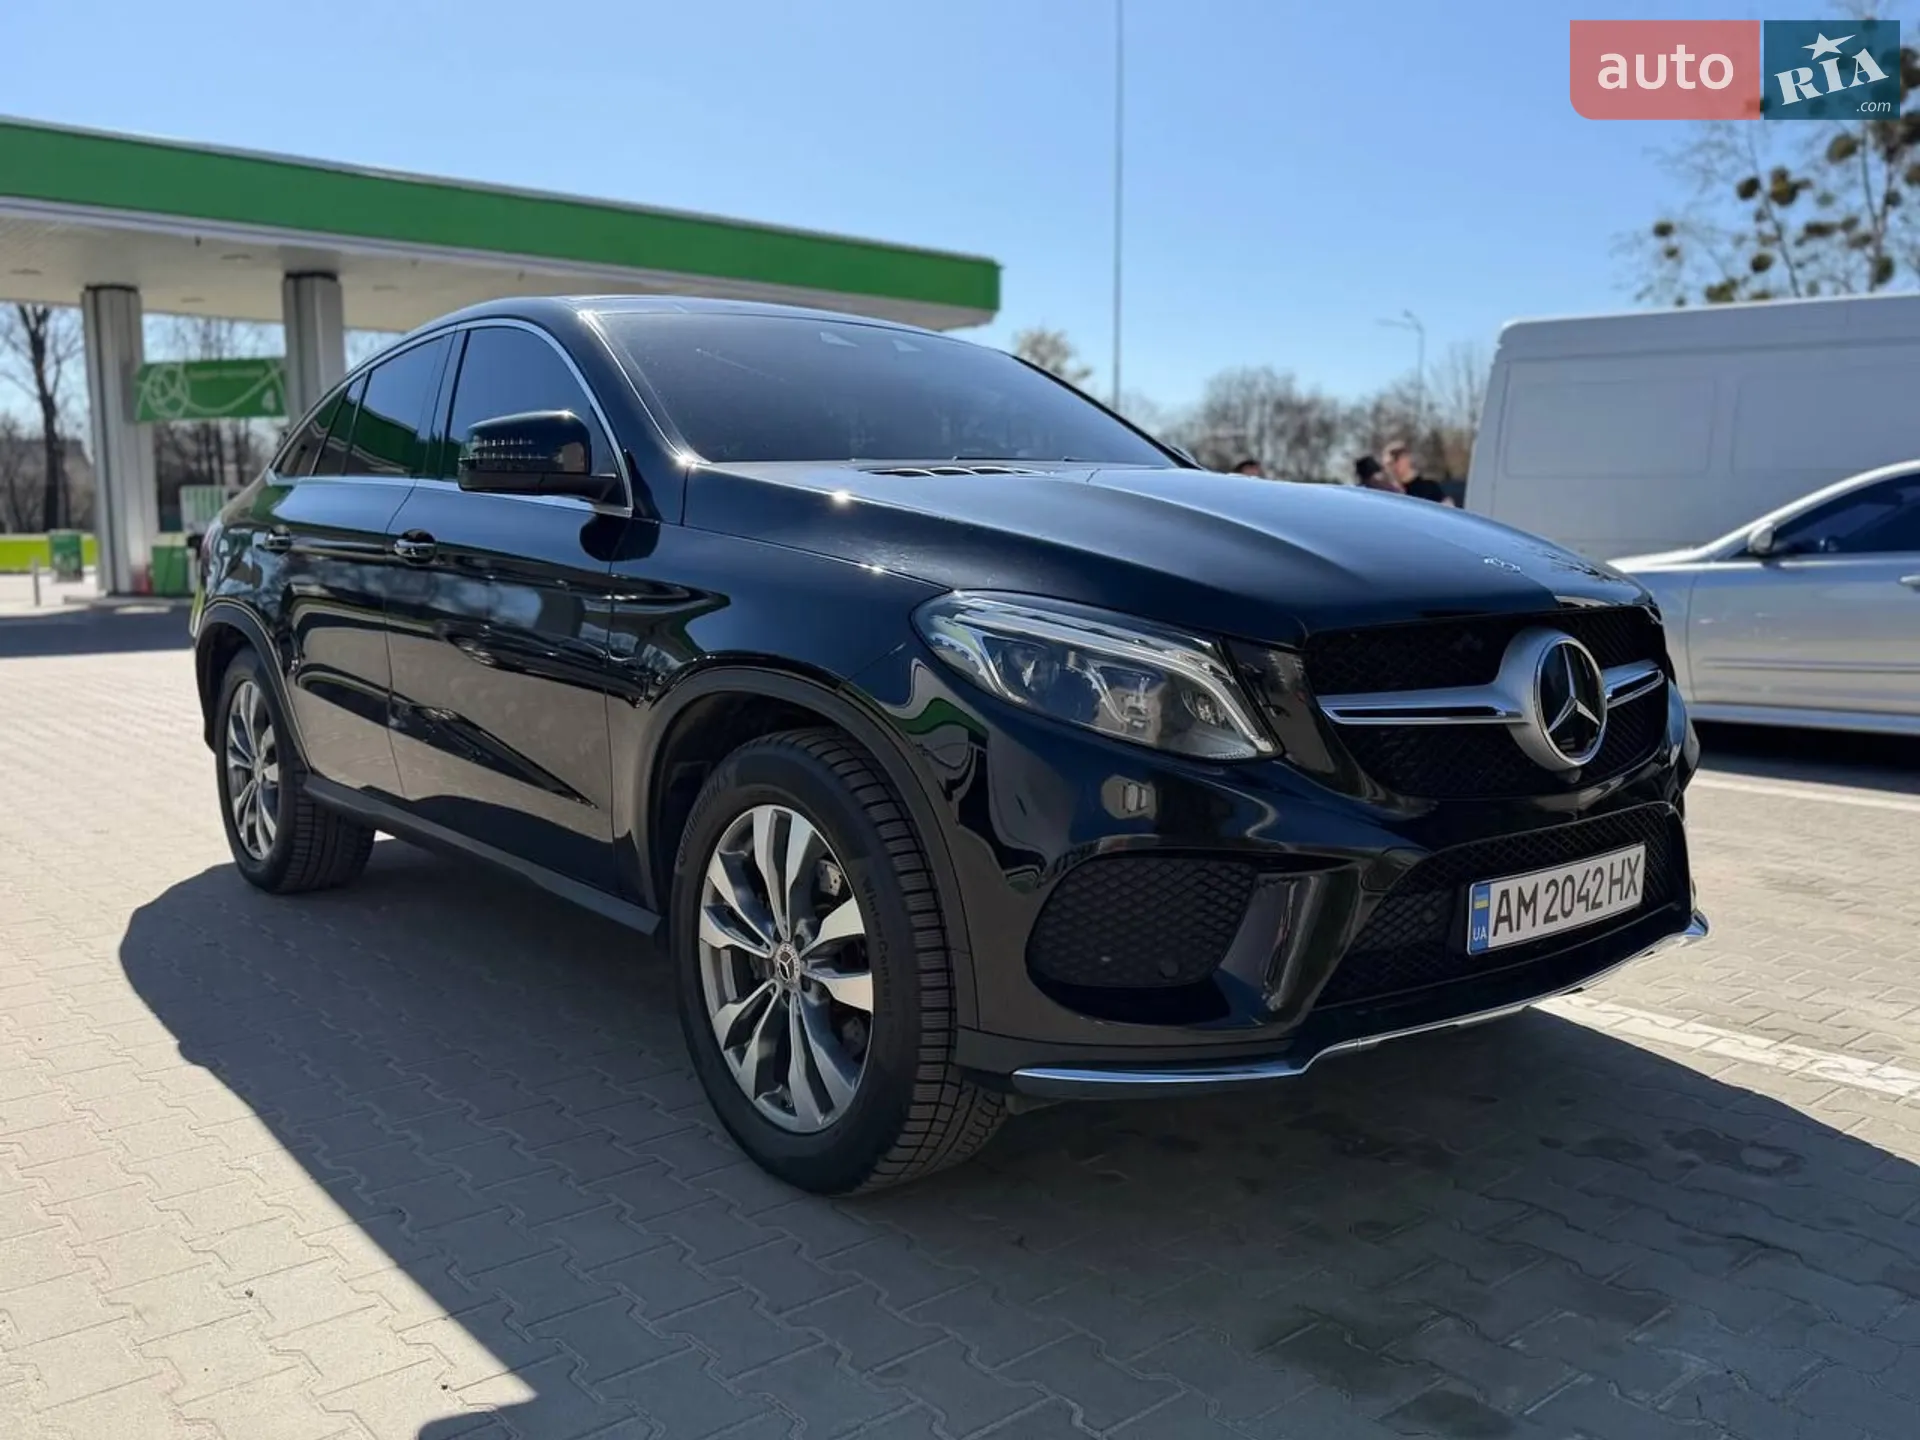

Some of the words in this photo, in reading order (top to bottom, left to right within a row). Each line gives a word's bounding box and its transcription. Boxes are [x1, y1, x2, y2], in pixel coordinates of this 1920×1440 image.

[1492, 881, 1539, 937] AM
[1543, 866, 1605, 925] 2042
[1607, 853, 1641, 906] HX
[1473, 927, 1488, 941] UA
